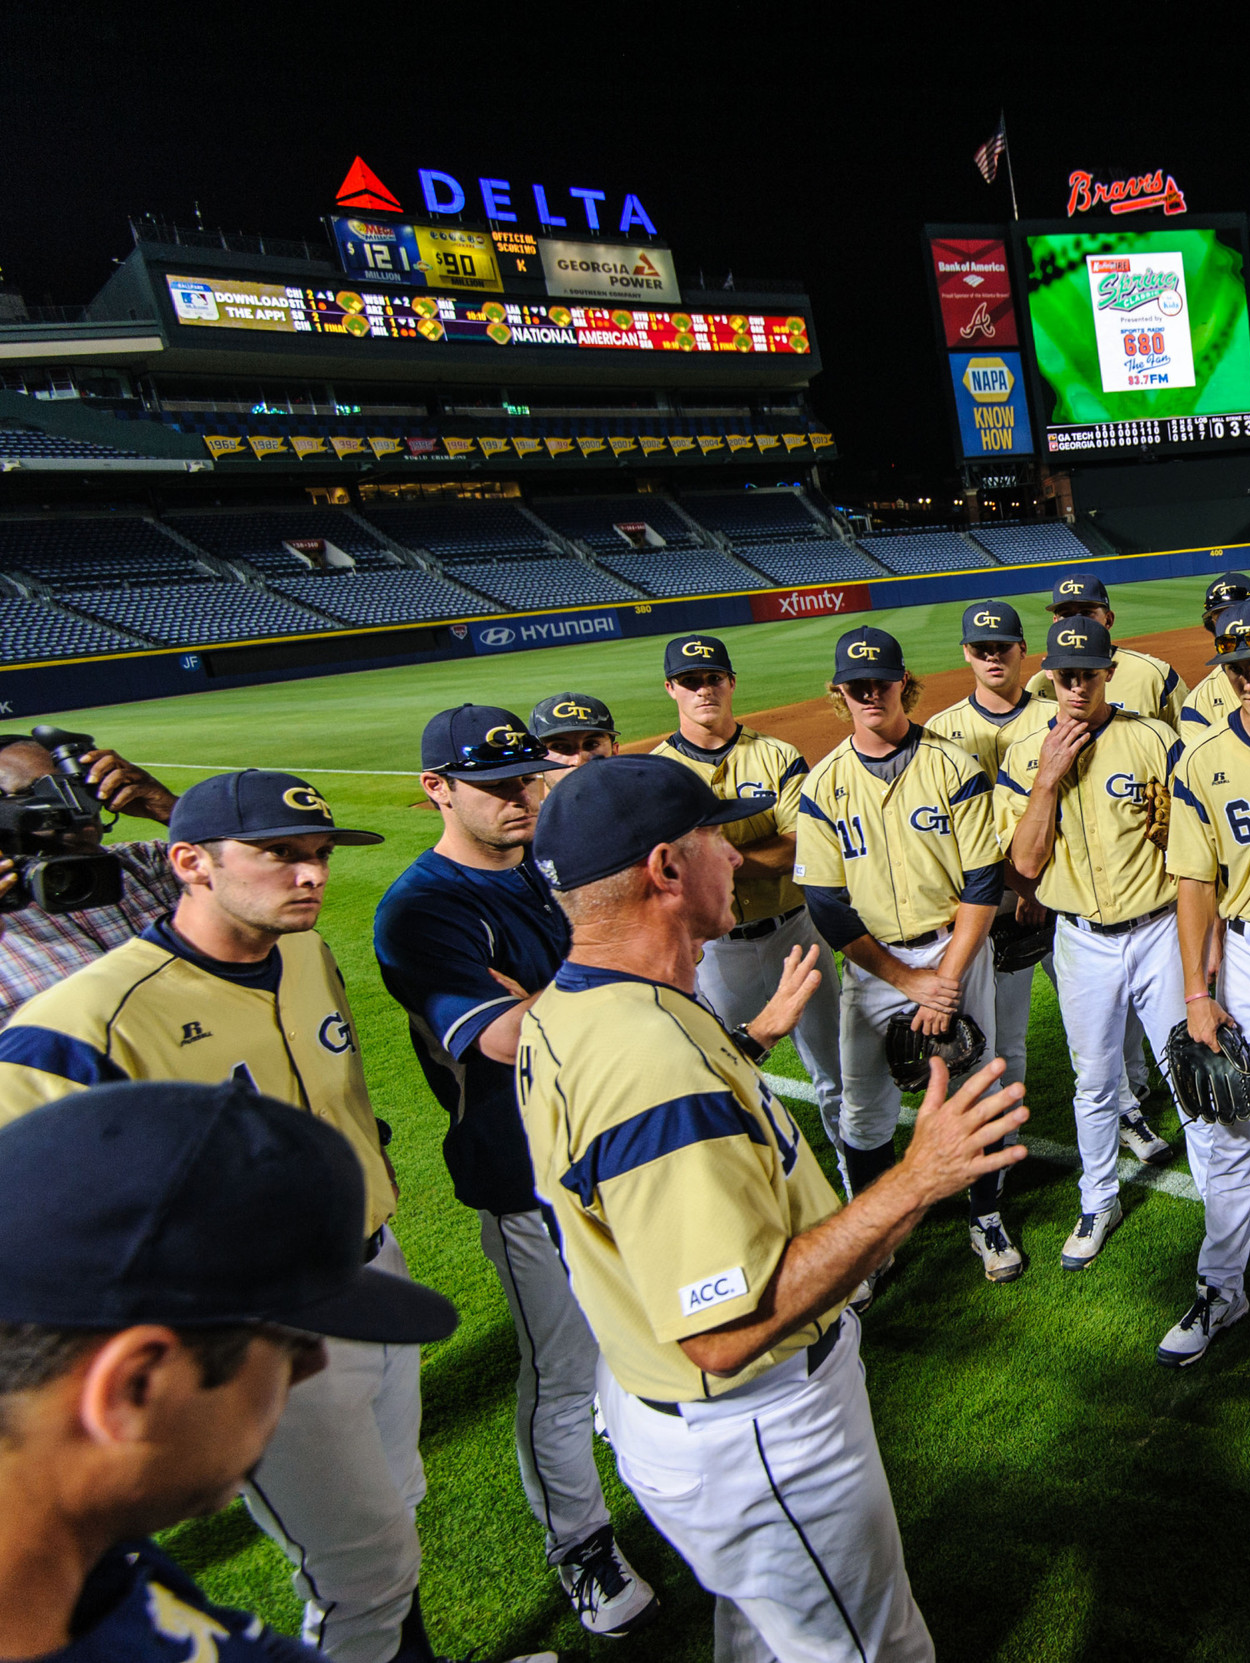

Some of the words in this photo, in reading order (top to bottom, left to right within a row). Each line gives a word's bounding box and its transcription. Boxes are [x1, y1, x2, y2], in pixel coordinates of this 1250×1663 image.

[1067, 169, 1162, 217] Braves
[418, 168, 658, 235] DELTA
[365, 223, 395, 235] MEGA
[491, 231, 536, 245] OFFICIAL
[516, 259, 526, 272] K
[557, 260, 629, 274] GEORGIA
[939, 262, 960, 272] Bank
[961, 262, 970, 272] of
[971, 262, 1005, 273] America
[364, 270, 401, 281] MILLION
[450, 277, 484, 288] MILLION
[609, 276, 662, 290] POWER
[285, 287, 303, 299] CHI
[306, 289, 314, 300] 2
[1097, 267, 1180, 310] Spring
[214, 292, 289, 308] DOWNLOAD
[288, 298, 306, 309] STL
[310, 301, 316, 310] 1
[403, 296, 410, 307] 2
[1123, 289, 1160, 308] CLASSIC
[225, 307, 253, 319] THE
[255, 309, 286, 322] APP!
[312, 312, 319, 321] 2
[390, 317, 396, 327] 1
[294, 321, 312, 331] CIN
[315, 323, 322, 332] 1
[323, 323, 348, 334] FINAL
[392, 328, 399, 337] 2
[511, 327, 577, 345] NATIONAL
[578, 330, 638, 346] AMERICAN
[1124, 332, 1164, 356] 680
[1124, 357, 1144, 372] The
[1147, 354, 1171, 369] Fan
[971, 369, 1008, 391] NAPA
[973, 406, 1014, 428] KNOW
[1058, 434, 1071, 443] GA
[1071, 432, 1094, 441] TECH
[1172, 425, 1178, 433] 2
[1214, 422, 1224, 438] 0
[1230, 421, 1240, 437] 3
[209, 440, 236, 450] 1969
[253, 440, 278, 450] 1982
[613, 440, 631, 448] 2001
[700, 439, 718, 447] 2004
[980, 428, 1012, 450] HOW
[1059, 441, 1095, 451] GEORGIA
[1173, 433, 1178, 442] 0
[1181, 433, 1187, 441] 5
[1188, 432, 1193, 441] 1
[1199, 431, 1205, 440] 7
[1059, 579, 1085, 595] GT
[635, 605, 651, 614] 380
[778, 589, 844, 616] xfinity
[974, 610, 1000, 628] GT
[520, 617, 614, 641] HYUNDAI
[1057, 629, 1088, 649] GT
[682, 641, 714, 659] GT
[847, 641, 881, 661] GT
[183, 656, 198, 669] JF
[552, 701, 592, 720] GT
[282, 786, 332, 820] GT
[909, 804, 951, 837] GT
[836, 815, 867, 861] 11
